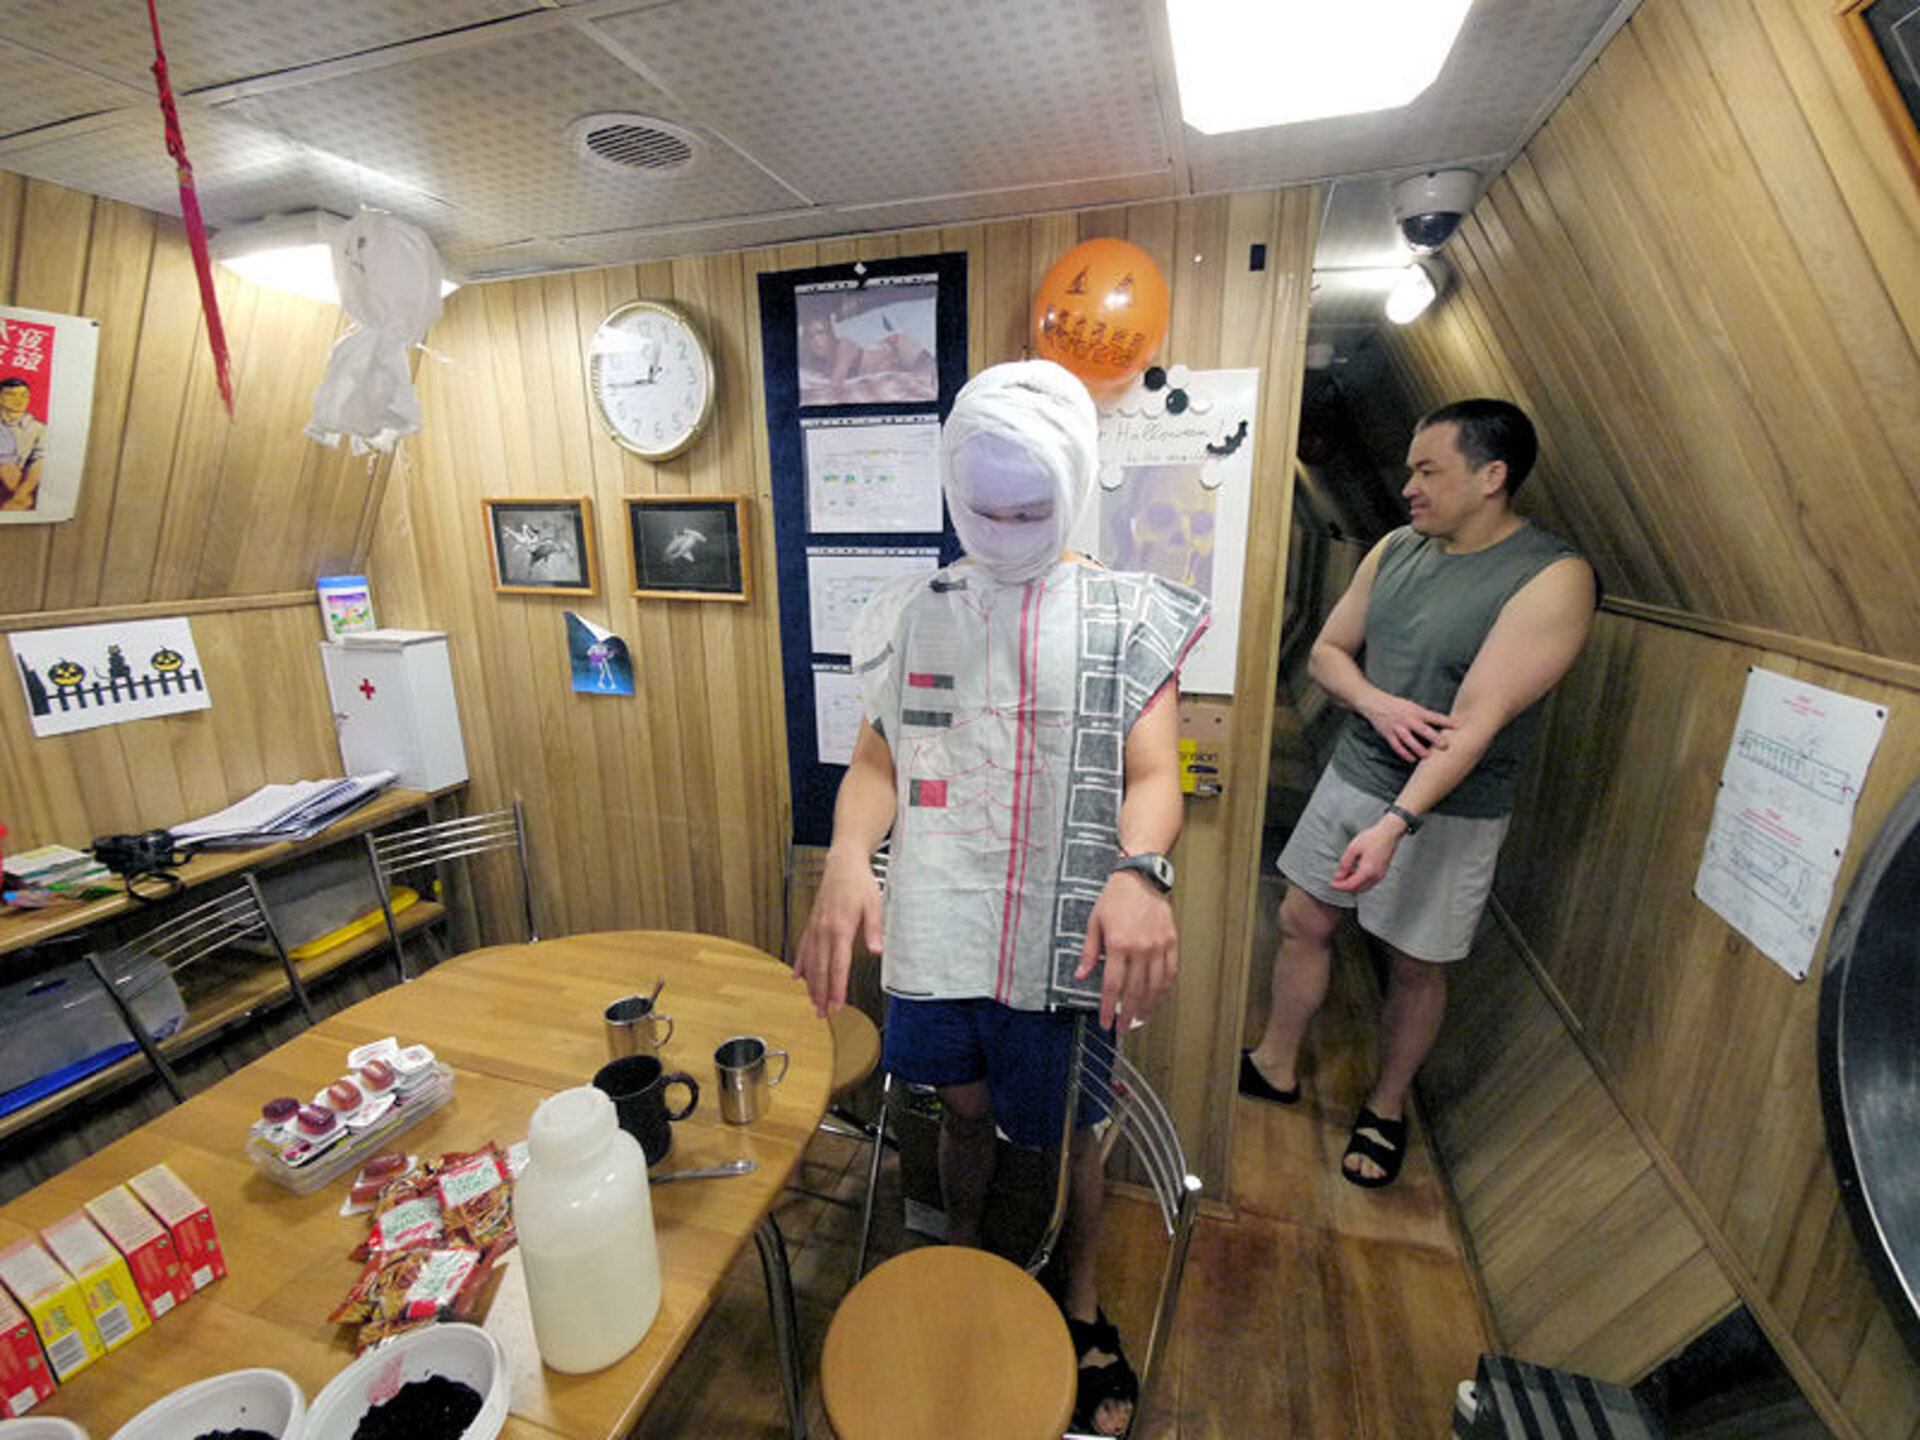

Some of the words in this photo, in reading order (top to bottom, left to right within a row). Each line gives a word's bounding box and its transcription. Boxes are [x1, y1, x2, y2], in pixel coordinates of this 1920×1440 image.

[677, 340, 689, 361] 2
[687, 366, 698, 386] 3
[685, 391, 695, 411] 4
[632, 417, 643, 437] 7
[654, 421, 664, 441] 6
[671, 411, 684, 431] 5
